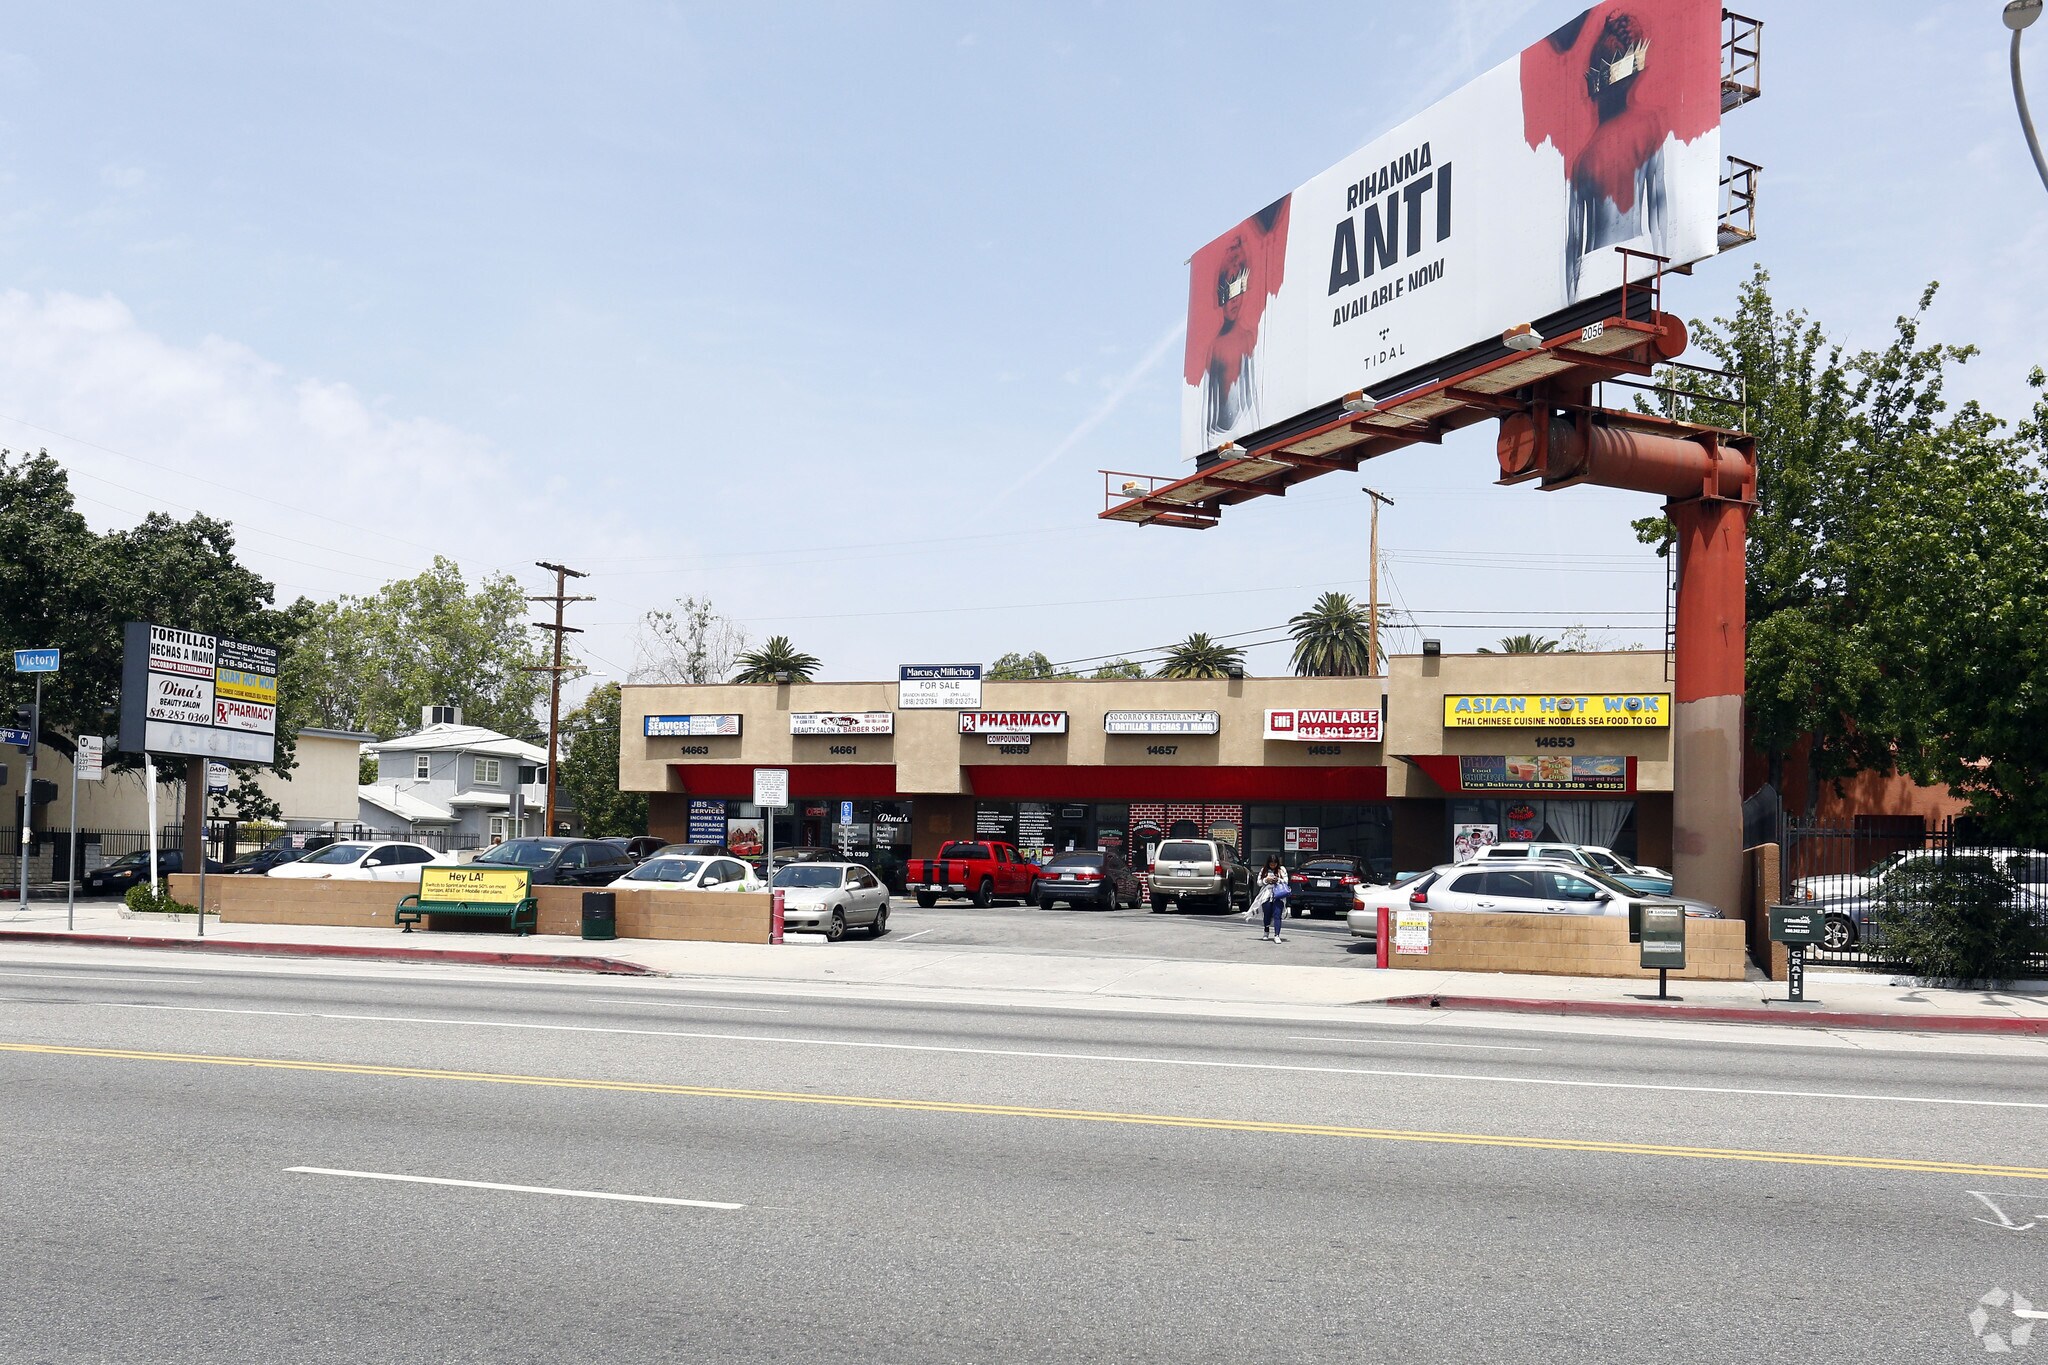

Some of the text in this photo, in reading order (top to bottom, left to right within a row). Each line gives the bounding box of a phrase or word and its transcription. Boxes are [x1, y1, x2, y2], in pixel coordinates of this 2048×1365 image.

[1347, 141, 1432, 212] RIHANNA
[1328, 161, 1452, 296] ANTI
[1333, 258, 1444, 327] AVAILABLE NOW
[1582, 323, 1603, 341] 2056
[1364, 343, 1405, 370] TIDAL
[151, 627, 215, 650] TORTILLAS
[150, 642, 214, 665] HECHAS A MANO
[219, 639, 277, 657] JBS SERVICES
[20, 654, 56, 666] Victory
[218, 657, 276, 675] 818-904-1559
[151, 659, 206, 675] SOCORRO'S RESTAURANT
[907, 667, 975, 678] Marcus & Millichap
[218, 669, 275, 690] ASIAN HOT WOK
[920, 681, 960, 690] FOR SALE
[159, 680, 203, 699] Dina's
[160, 698, 201, 709] BEAUTY SALON
[903, 698, 915, 706] (818)
[942, 698, 954, 706] (818)
[1455, 696, 1659, 713] ASIAN HOT WOK
[149, 707, 210, 724] 818-285 0369
[229, 703, 274, 721] PHARMACY
[1109, 713, 1148, 721] SOCORRO'S
[1300, 711, 1377, 723] AVAILABLE
[648, 721, 690, 730] SERVICES
[979, 713, 1061, 726] PHARMACY
[1456, 717, 1657, 726] THAI CHINESE CUISINE NOODLES SEA FOOD TO GO
[1110, 722, 1213, 731] TORTILLAS HECHAS A MANO
[1299, 726, 1377, 738] 818.501.2212
[21, 732, 28, 740] Av
[988, 735, 1029, 743] COMPOUNDING
[1535, 737, 1576, 747] 14653
[680, 746, 709, 754] 14663
[829, 746, 857, 754] 14661
[1000, 746, 1030, 754] 14659
[1146, 746, 1178, 755] 14657
[1307, 746, 1341, 755] 14655
[1462, 755, 1506, 768] THAI
[1463, 773, 1506, 782] CHINESE
[877, 813, 909, 823] Dina's
[449, 872, 484, 883] Hey LA!
[1791, 950, 1802, 995] GRATIS
